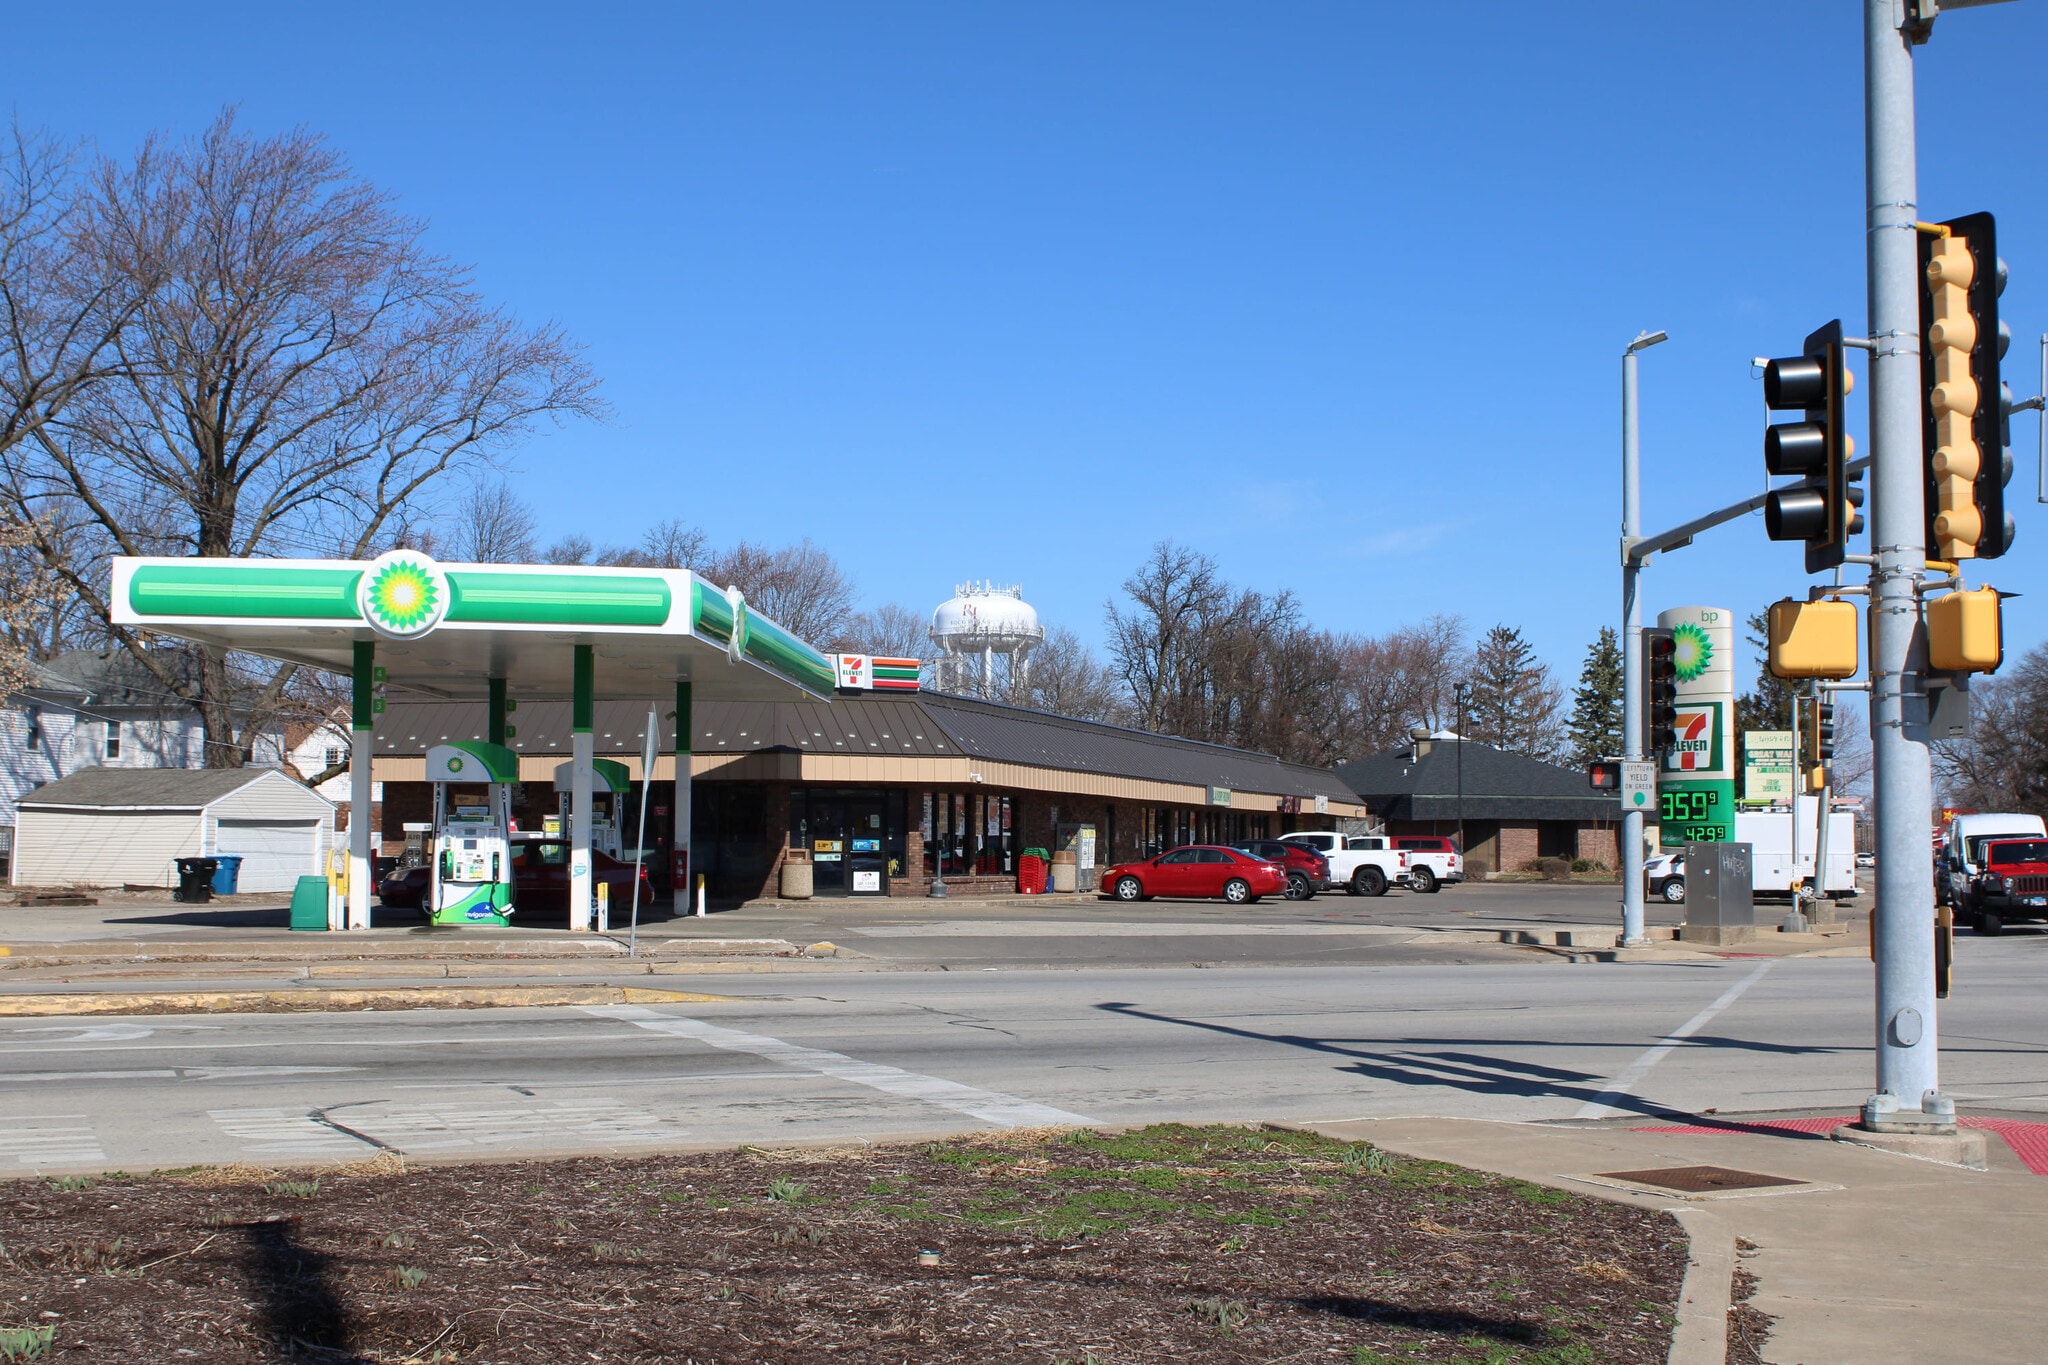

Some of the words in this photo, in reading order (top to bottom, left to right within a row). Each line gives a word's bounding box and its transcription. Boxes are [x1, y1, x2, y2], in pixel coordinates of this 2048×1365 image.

[1701, 610, 1718, 623] bp
[844, 657, 862, 684] 7
[1630, 773, 1648, 781] YIELD
[464, 911, 495, 919] invigorate
